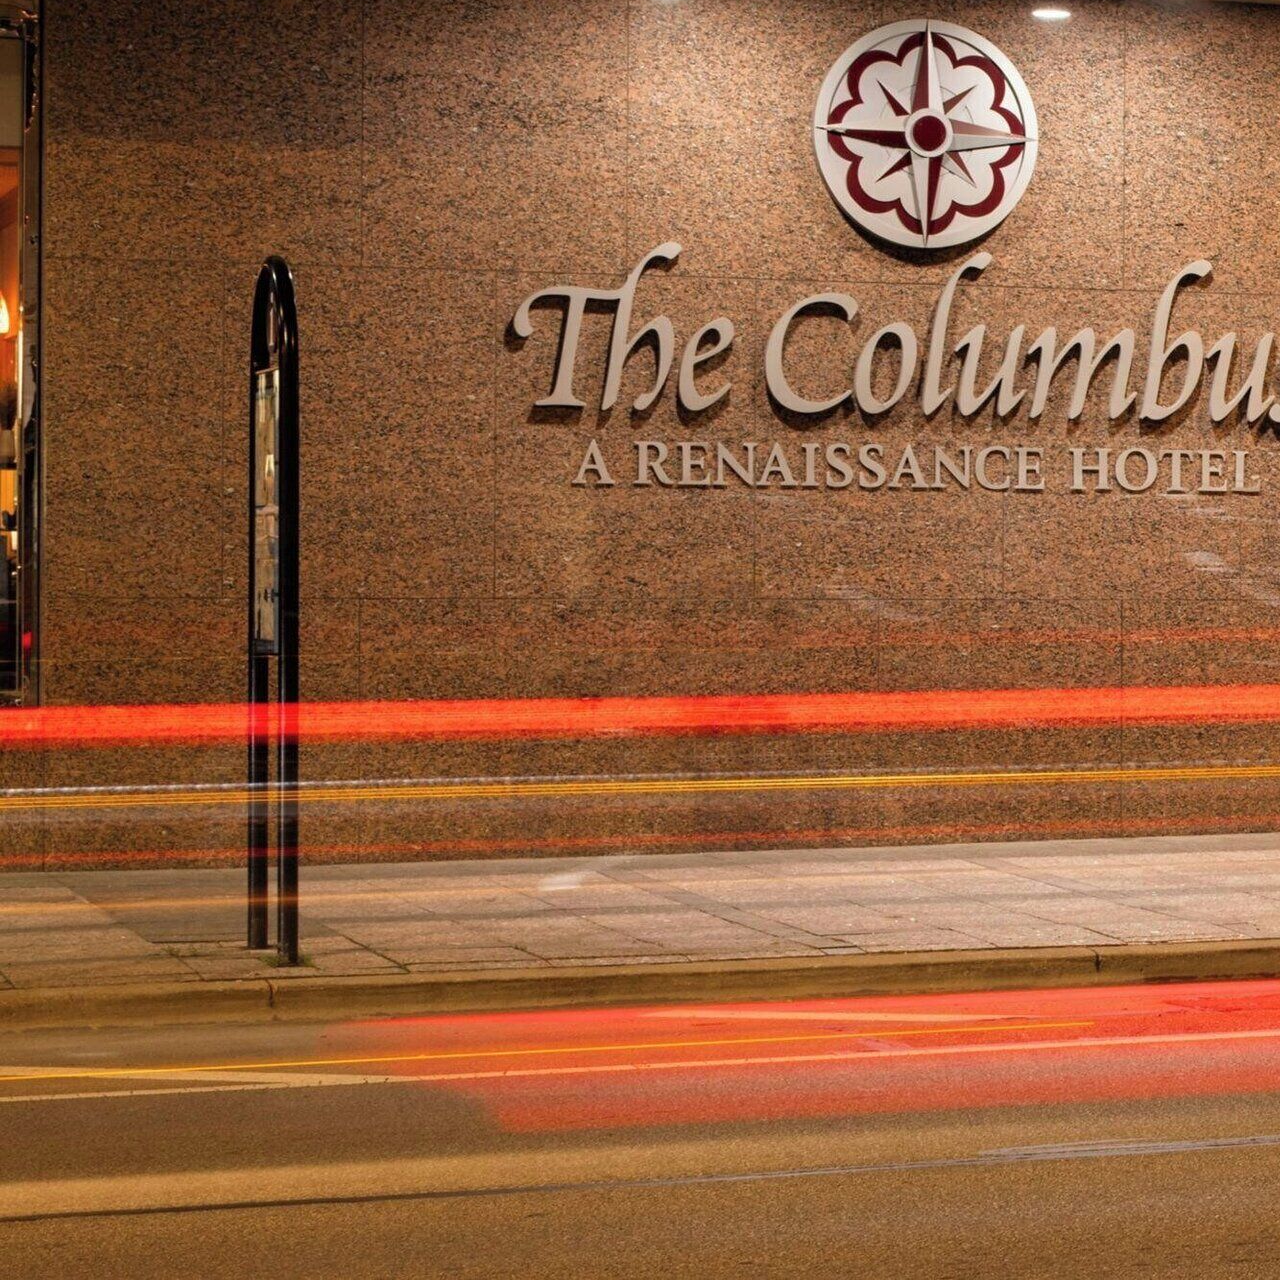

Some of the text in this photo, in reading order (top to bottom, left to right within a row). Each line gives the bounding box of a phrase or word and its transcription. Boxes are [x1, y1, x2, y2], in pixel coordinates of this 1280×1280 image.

[513, 241, 735, 412] The
[571, 438, 1262, 494] A RENAISSANCE HOTEL
